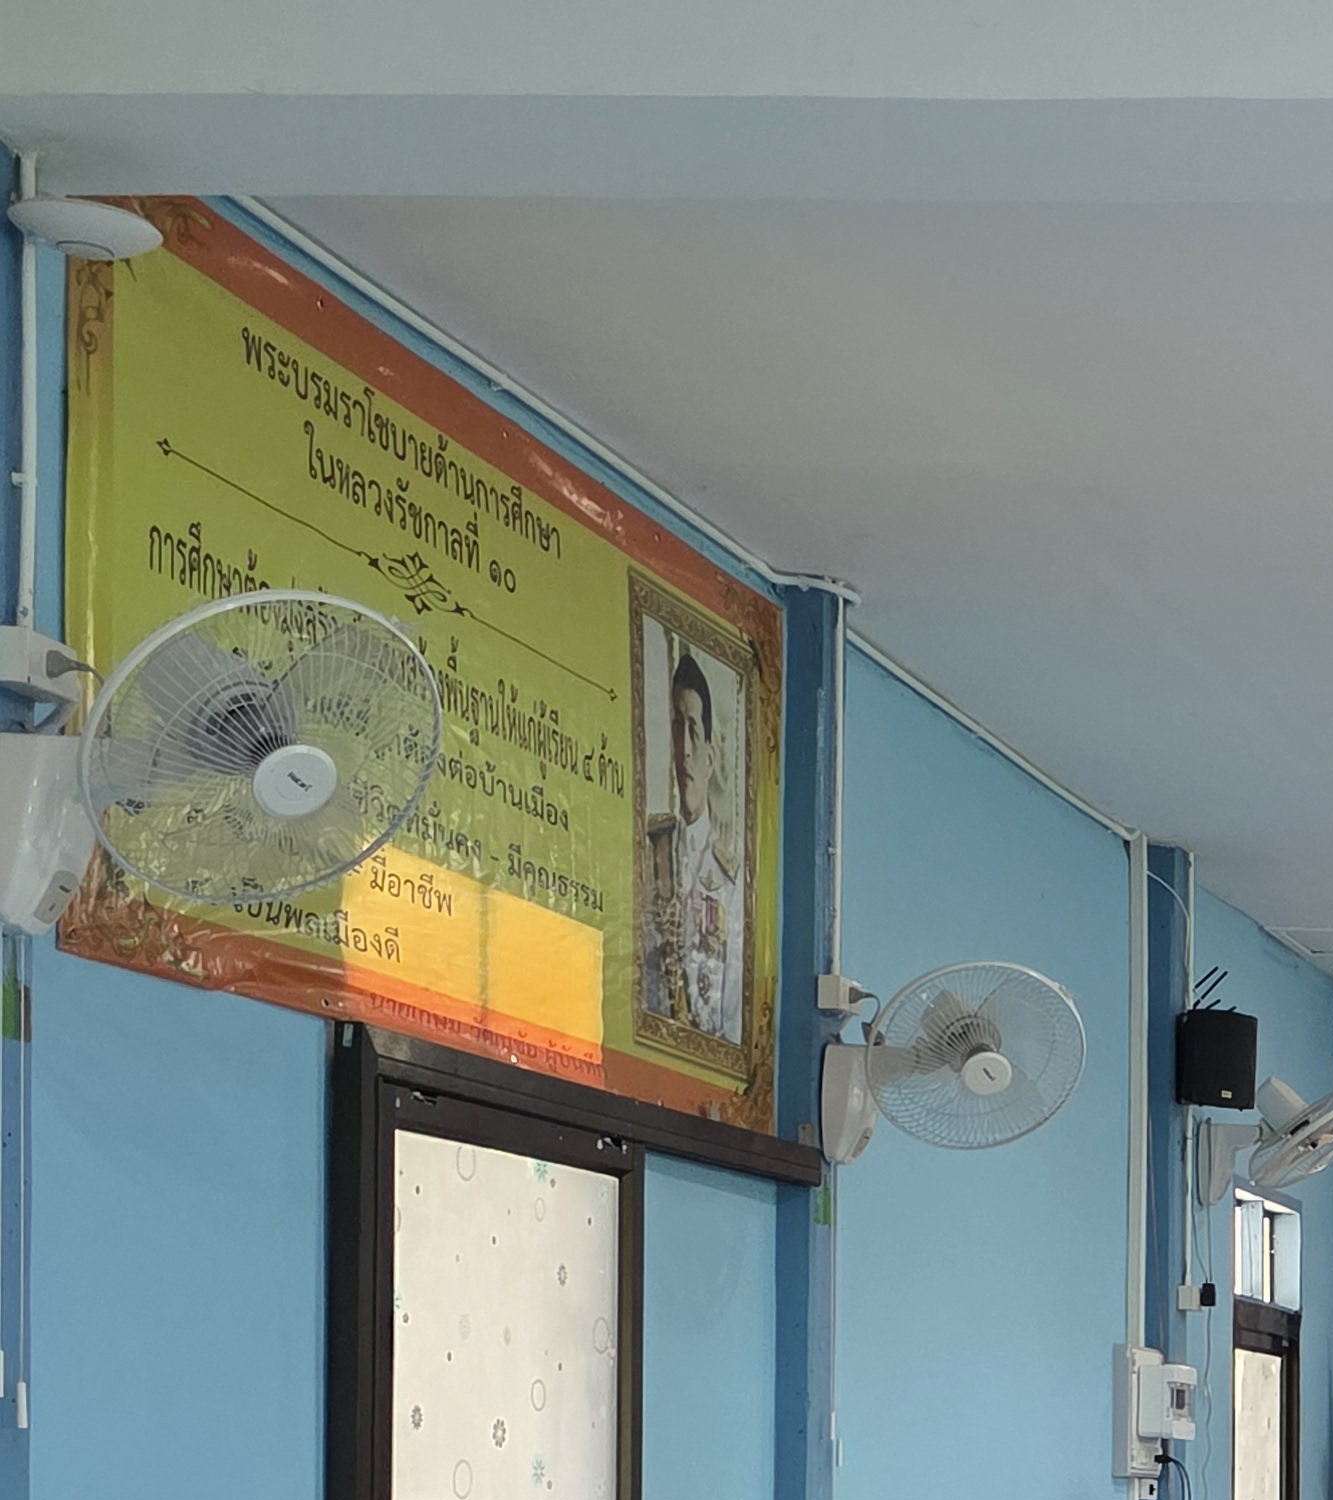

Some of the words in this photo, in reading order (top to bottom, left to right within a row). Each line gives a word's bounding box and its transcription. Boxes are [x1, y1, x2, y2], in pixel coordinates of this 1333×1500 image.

[241, 327, 561, 560] พระบรมราโชบายด้านการศึกษา
[303, 420, 481, 574] ในหลวงรัชกาลที่
[489, 559, 516, 594] ๑๐
[582, 747, 594, 783] ๔
[598, 732, 625, 798] ด้าน
[369, 852, 453, 916] มีอาชีพ
[508, 843, 603, 912] มีคุณธรรม
